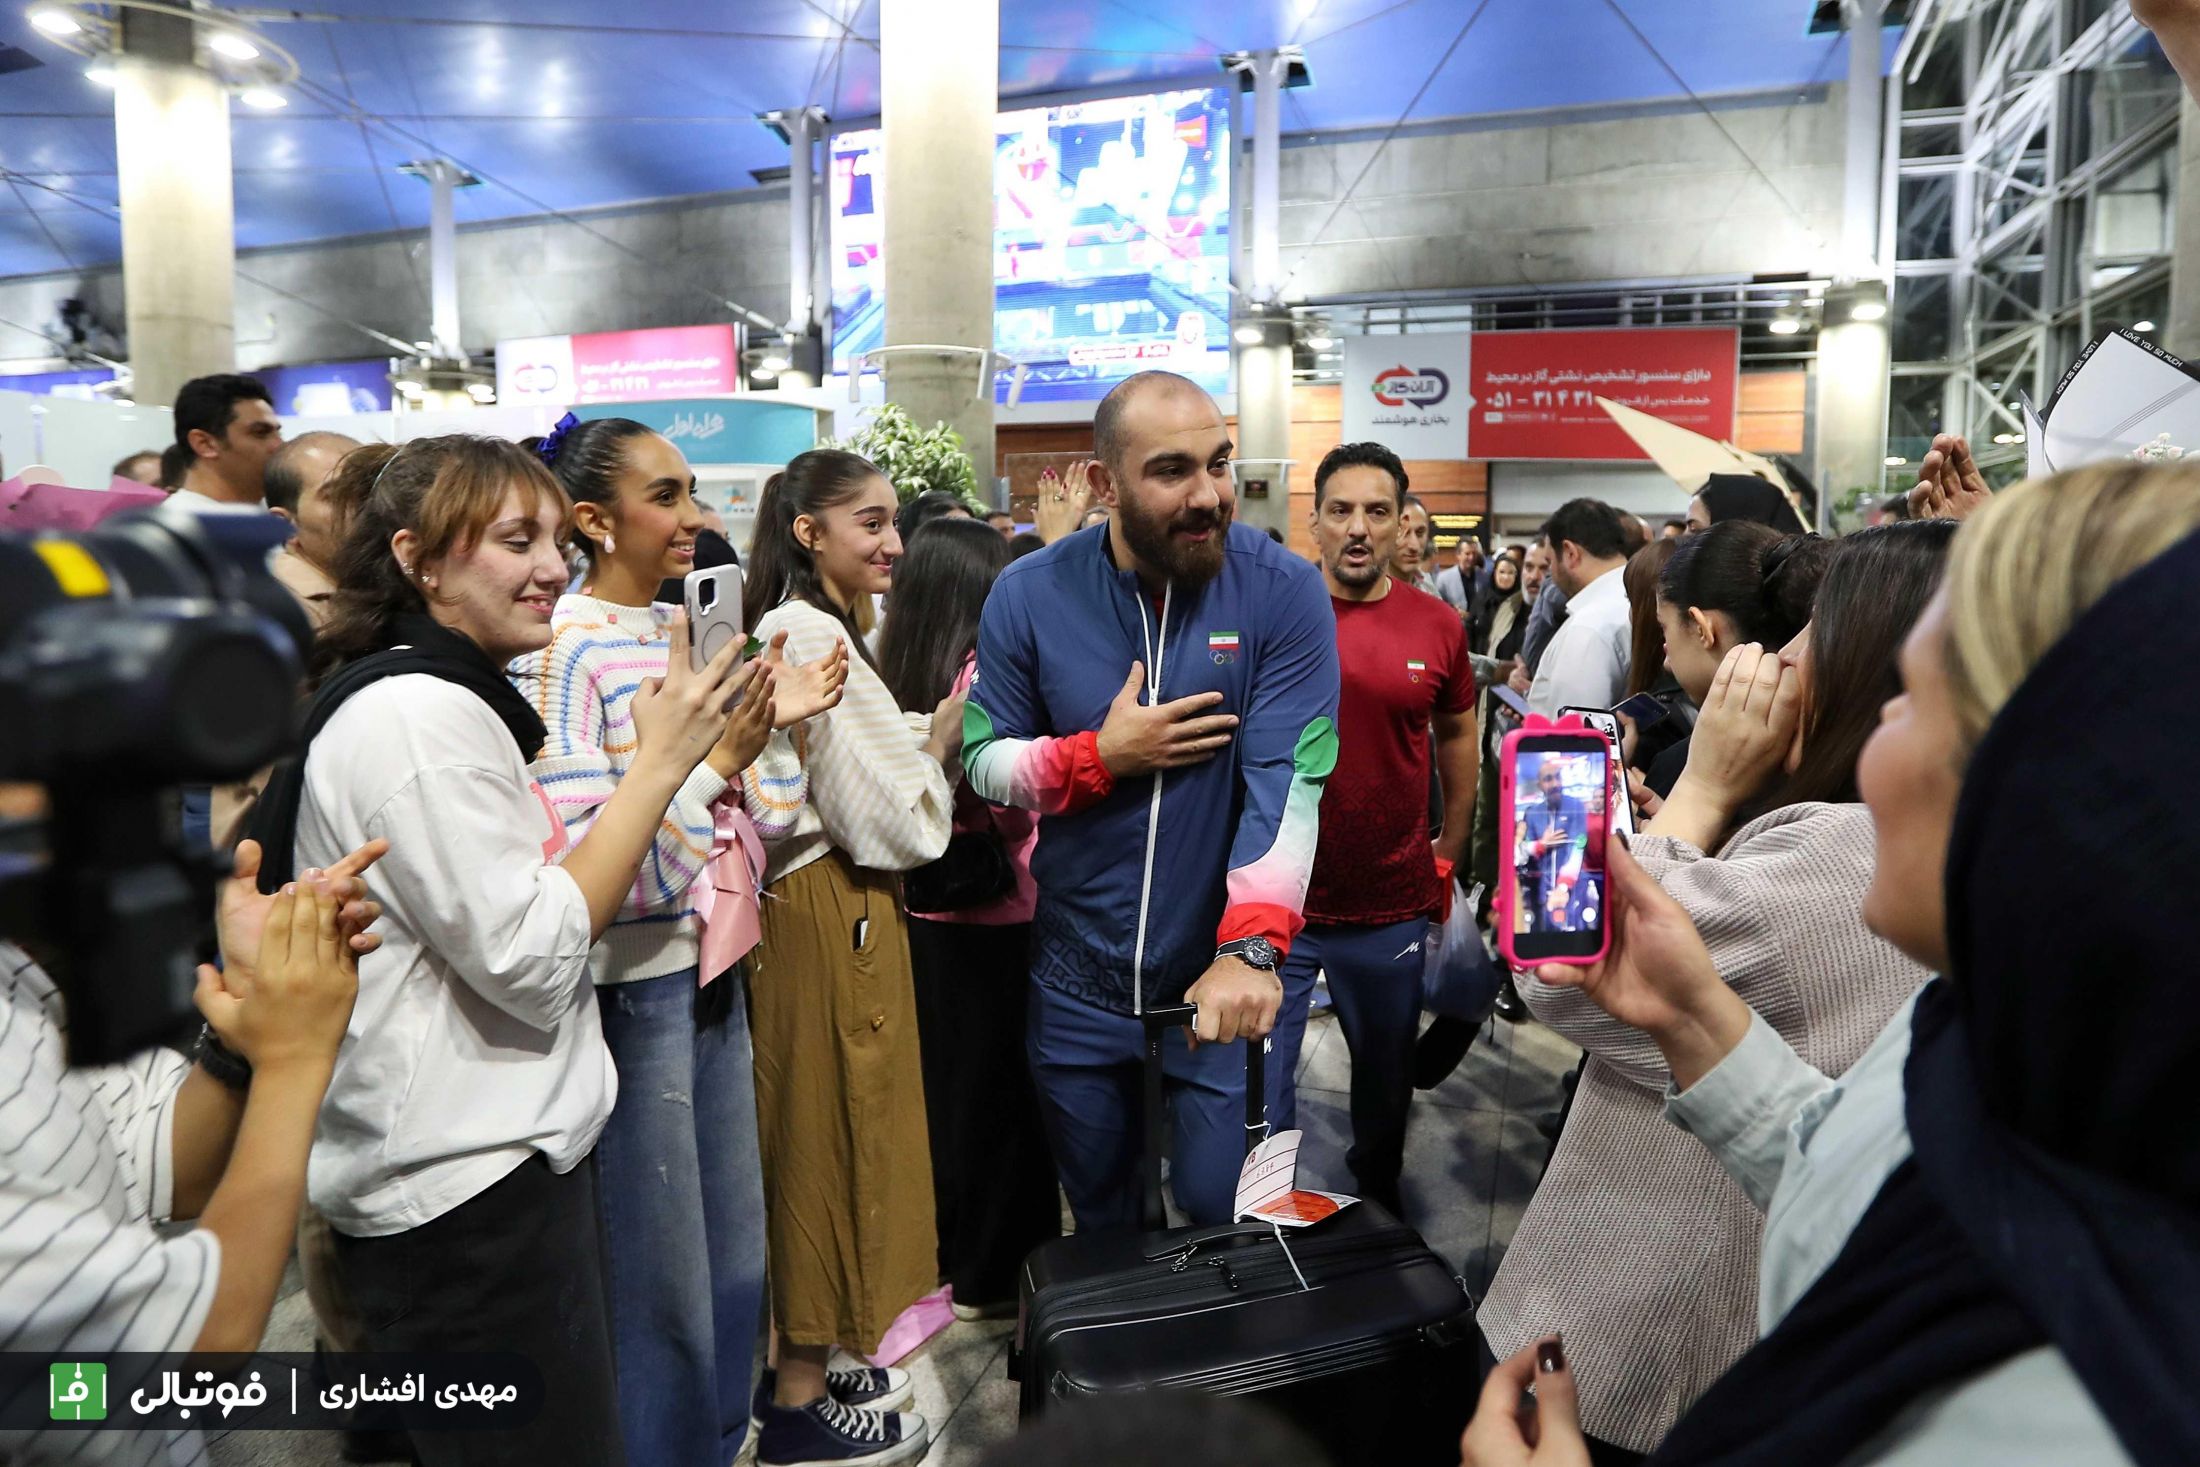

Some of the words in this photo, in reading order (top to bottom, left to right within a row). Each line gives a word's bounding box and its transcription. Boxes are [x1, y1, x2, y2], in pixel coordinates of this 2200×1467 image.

[2082, 343, 2096, 359] LOVE
[2123, 329, 2141, 343] LOVE
[2140, 339, 2154, 351] YOU
[2153, 347, 2164, 357] SO
[2163, 353, 2183, 367] MUCH
[2072, 358, 2084, 371] YOU
[1584, 369, 1635, 384] تشخیص
[1635, 369, 1681, 384] سنسور
[2065, 369, 2075, 380] SO
[2056, 379, 2068, 395] MUCH
